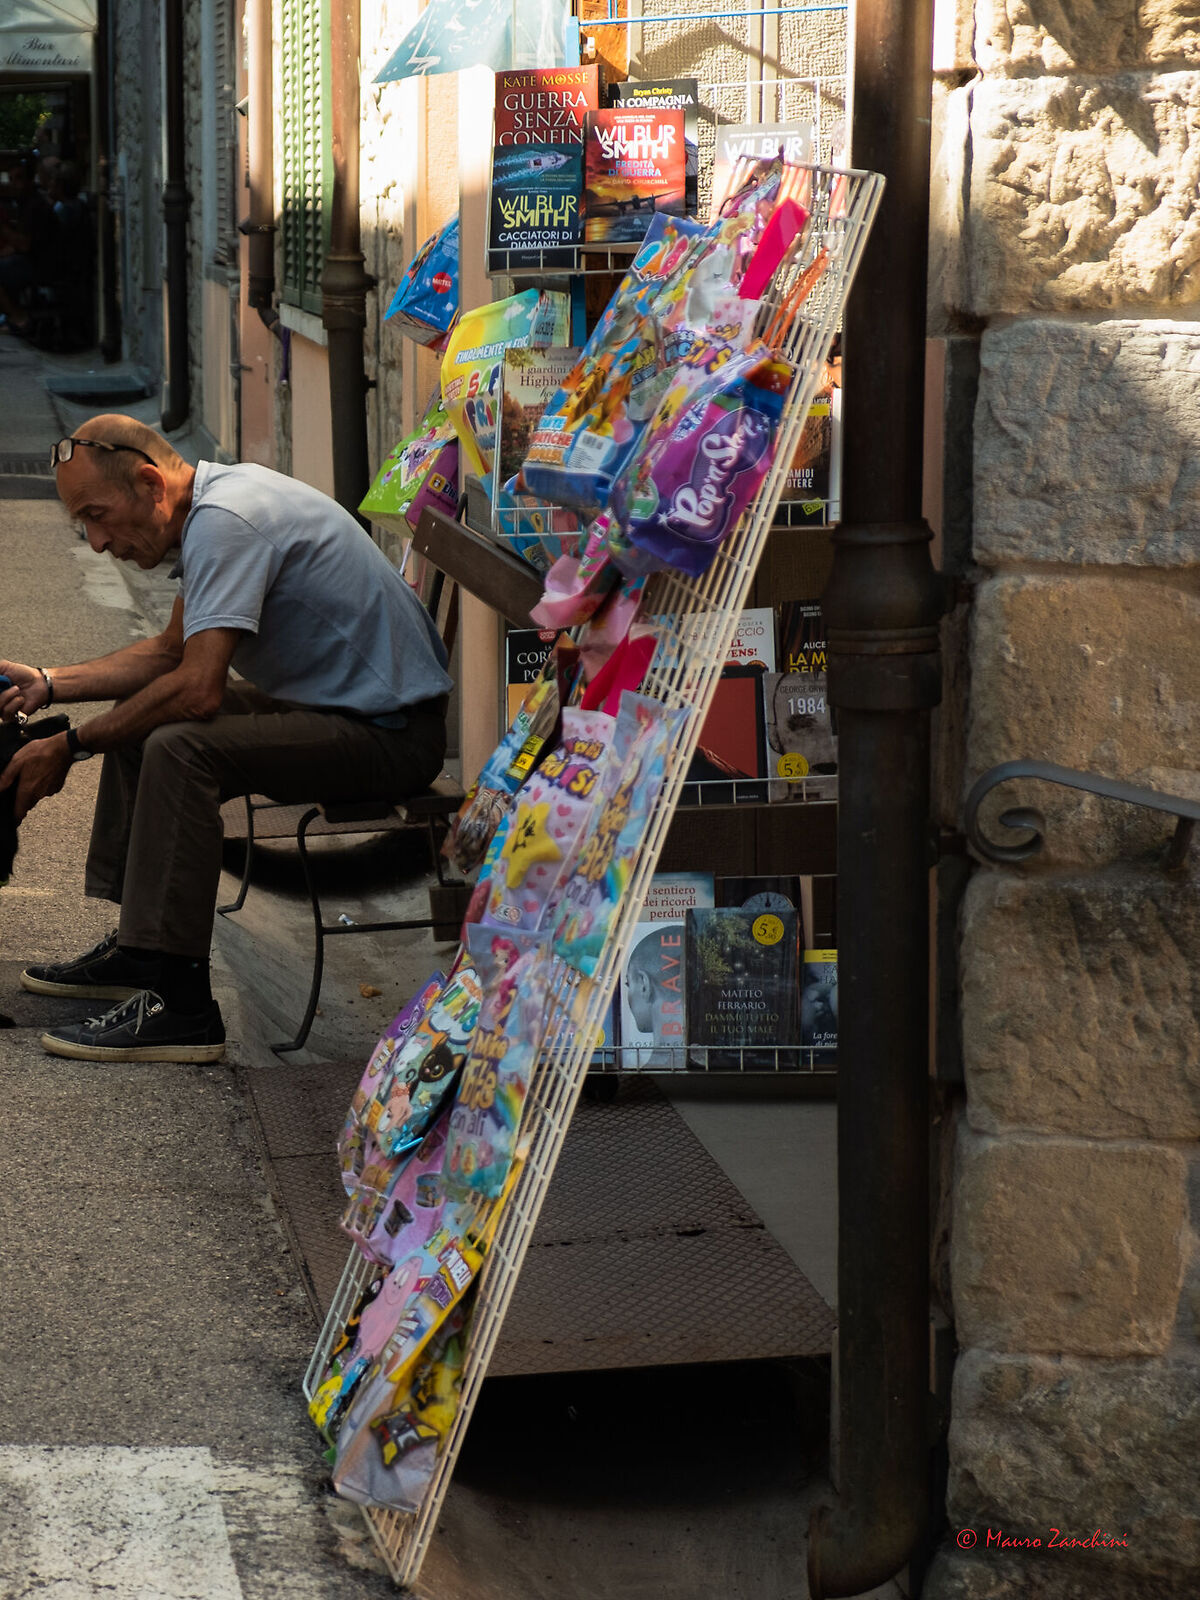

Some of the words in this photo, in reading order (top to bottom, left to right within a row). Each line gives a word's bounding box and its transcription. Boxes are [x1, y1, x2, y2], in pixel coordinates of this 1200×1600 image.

[22, 37, 56, 50] Bar
[503, 75, 537, 89] KATE
[541, 72, 589, 87] MOSSE
[503, 90, 589, 111] GUERRA
[613, 99, 625, 108] IN
[626, 93, 694, 108] COMPAGNIA
[513, 110, 579, 130] SENZA
[594, 125, 676, 146] WILBUR
[601, 140, 669, 159] SMITH
[608, 169, 619, 177] DI
[621, 168, 662, 177] GUERRA
[497, 195, 577, 215] WILBUR
[503, 209, 570, 228] SMITH
[498, 230, 560, 242] CACCIATORI
[561, 230, 573, 240] DI
[510, 241, 560, 249] DIAMANTI
[455, 341, 504, 365] FINALMENTE
[527, 364, 567, 376] giardini
[803, 641, 827, 650] ALICE
[789, 652, 808, 666] LA
[787, 697, 825, 715] 1984
[652, 884, 696, 895] sentiero
[642, 896, 658, 907] dei
[661, 895, 696, 906] ricordi
[660, 935, 683, 1036] BRAVE
[720, 988, 763, 999] MATTEO
[717, 1000, 767, 1010] FERRARIO
[705, 1012, 742, 1023] DAMMI
[744, 1012, 779, 1023] TUTTO
[709, 1024, 719, 1034] IL
[720, 1024, 744, 1034] TUO
[747, 1024, 777, 1034] MALE
[812, 1031, 822, 1039] La
